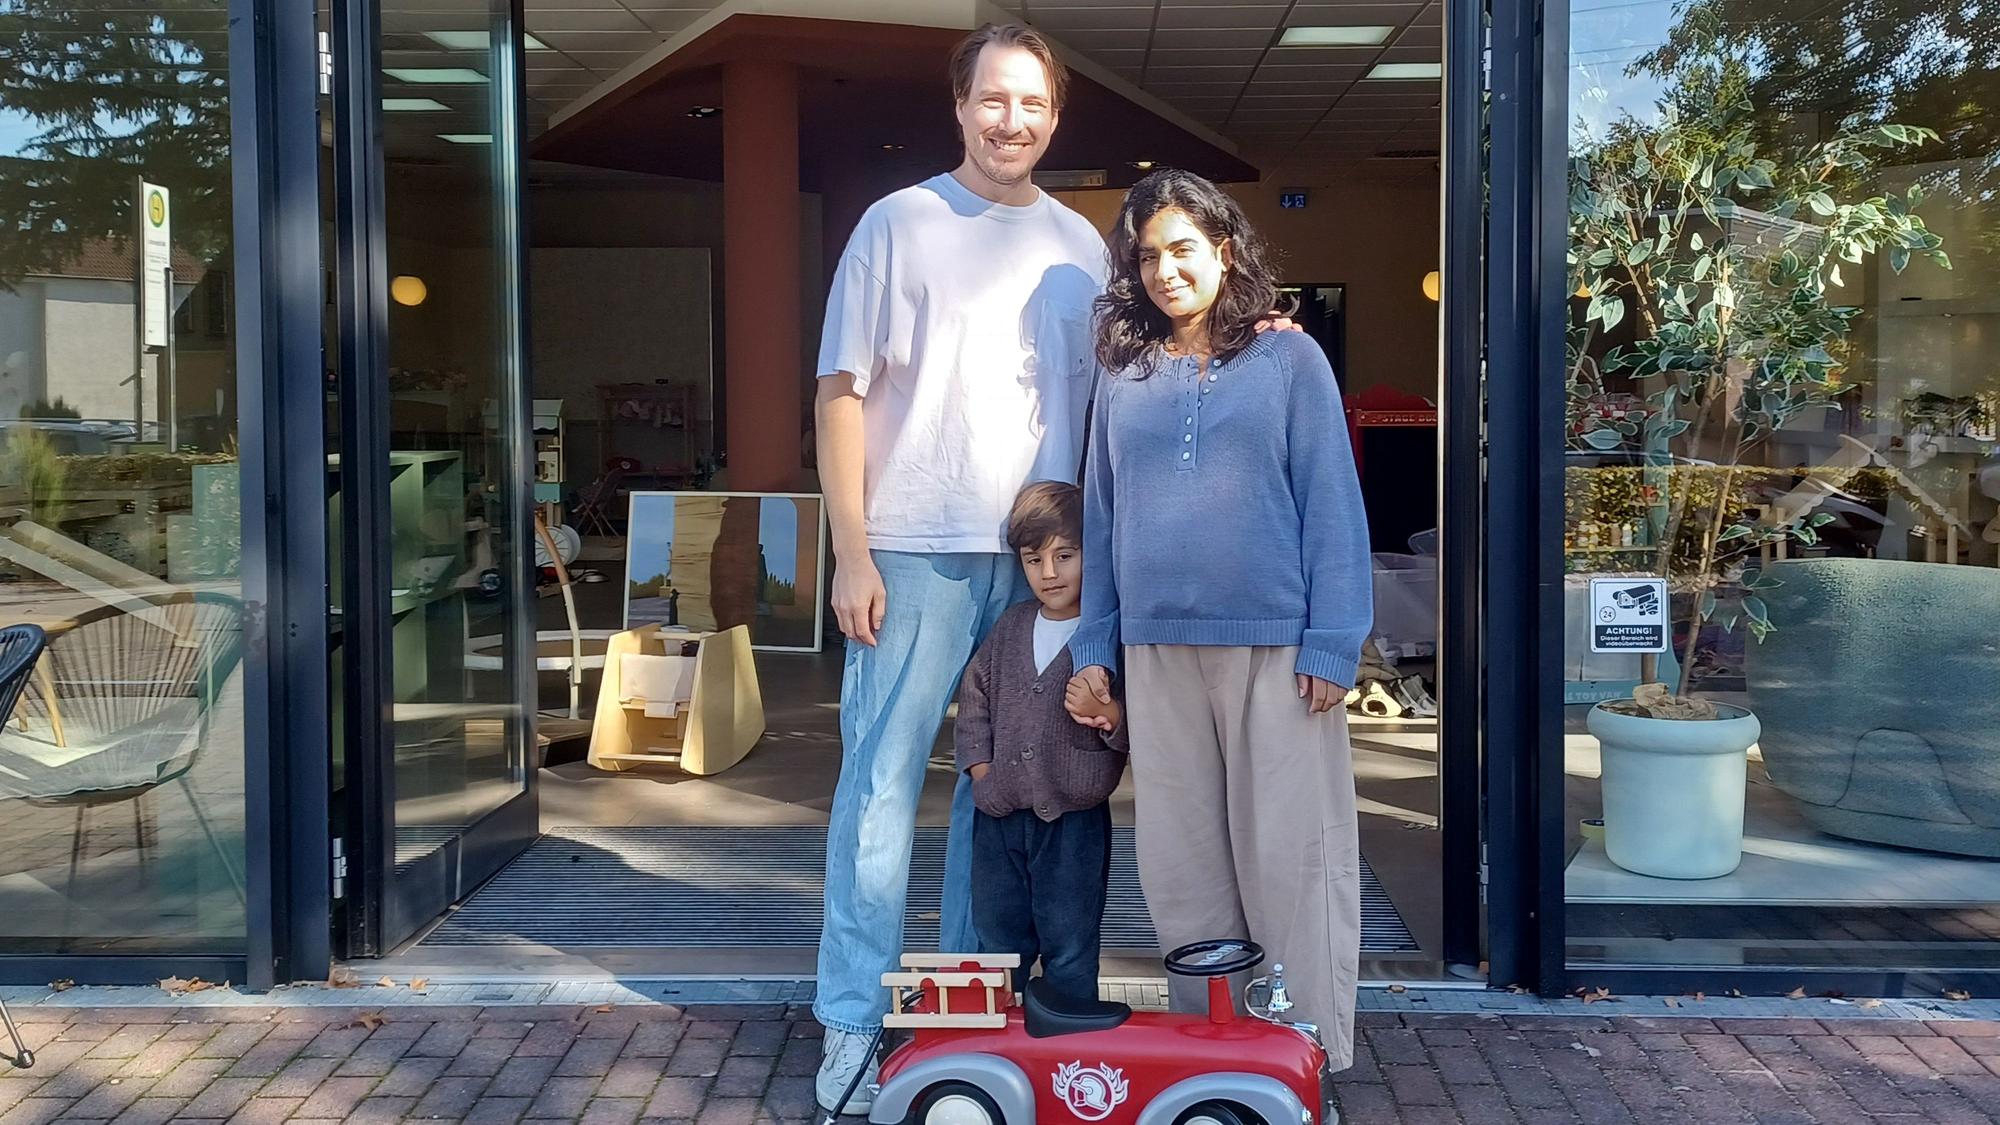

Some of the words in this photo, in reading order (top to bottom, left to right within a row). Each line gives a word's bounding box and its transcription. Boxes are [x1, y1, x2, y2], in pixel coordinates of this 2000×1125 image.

[1603, 610, 1612, 618] 24
[1605, 627, 1652, 635] ACHTUNG!
[1575, 692, 1597, 701] TOY
